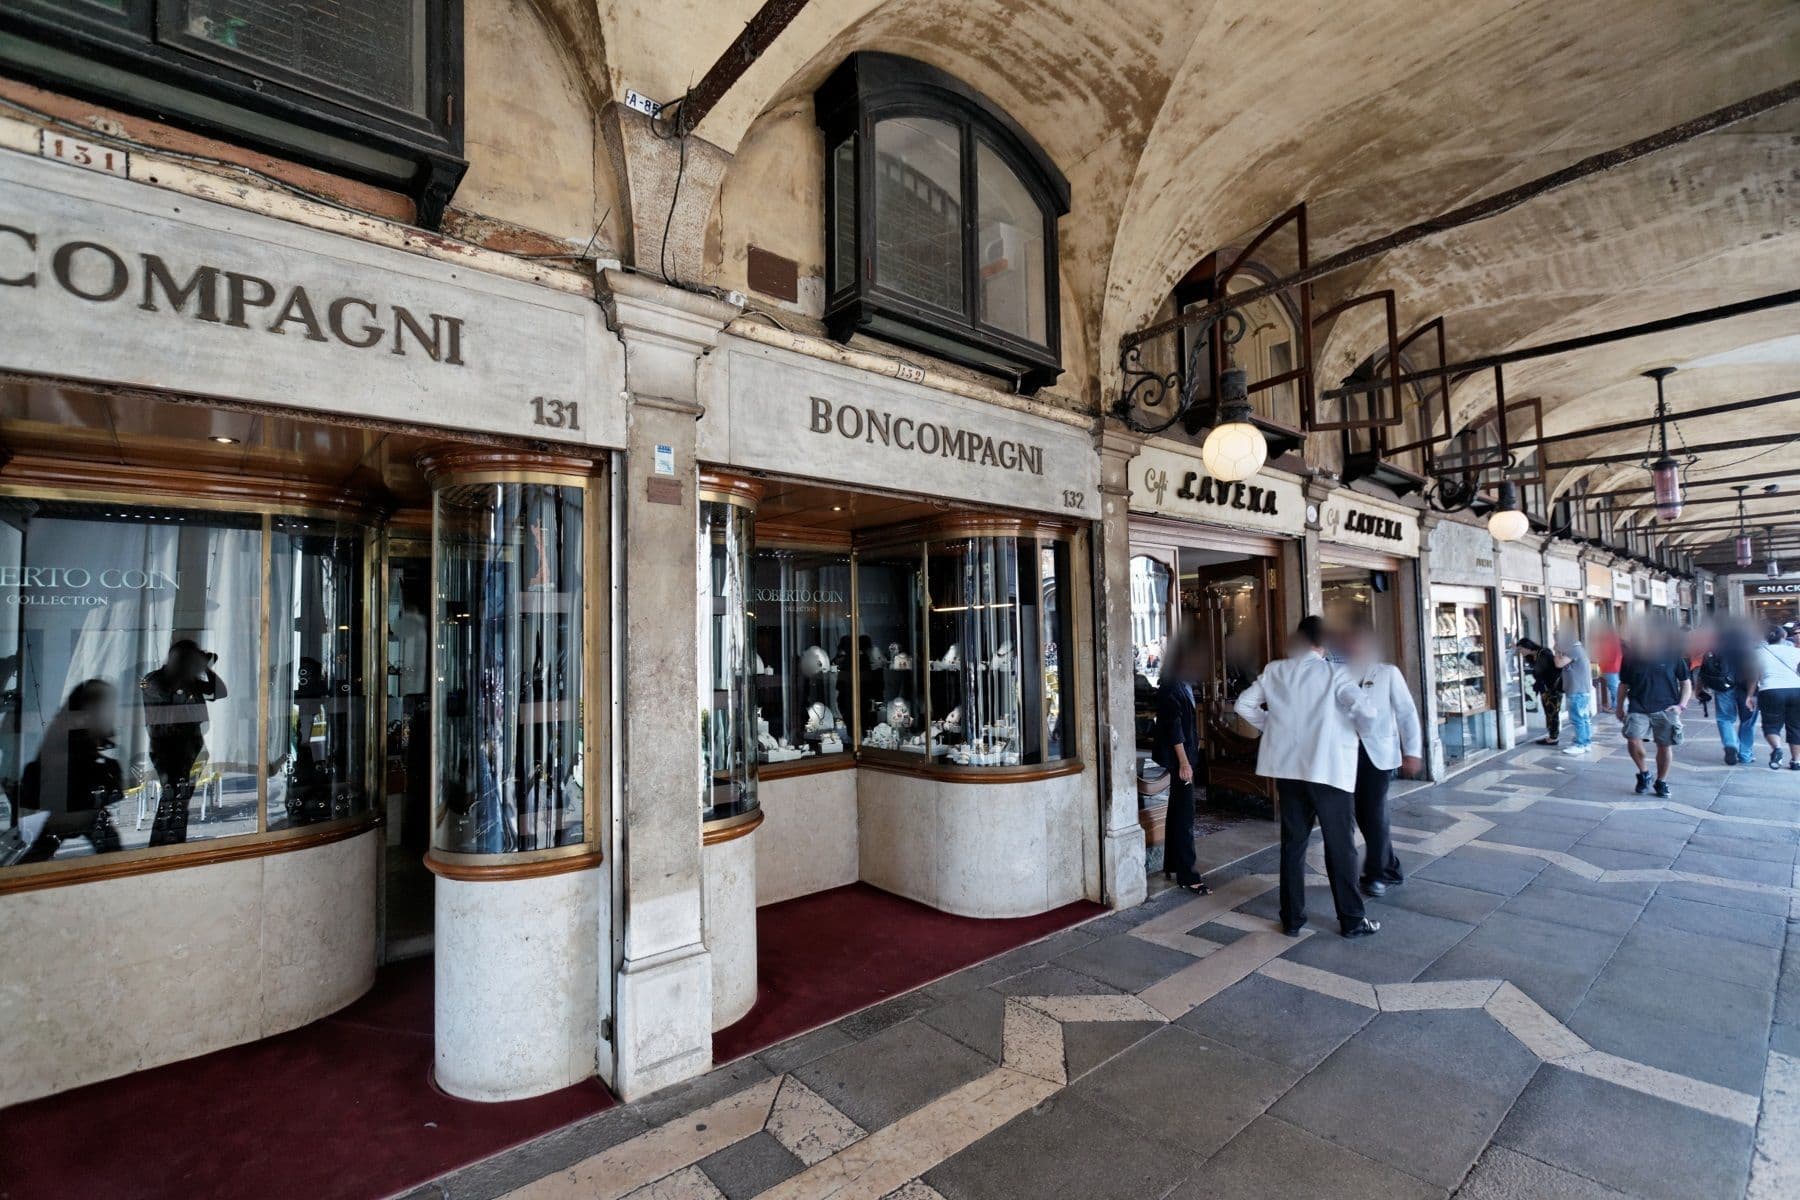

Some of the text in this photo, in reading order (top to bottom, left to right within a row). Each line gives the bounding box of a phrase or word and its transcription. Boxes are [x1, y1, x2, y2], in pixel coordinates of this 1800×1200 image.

[55, 140, 114, 171] 131
[530, 396, 580, 430] 131
[809, 396, 1044, 476] BONCOMPAGNI
[1063, 490, 1086, 509] 132
[1177, 471, 1279, 516] LAVENA
[1344, 510, 1403, 541] LAVENA
[100, 569, 182, 591] COIN
[6, 594, 108, 606] COLLECTION
[813, 591, 843, 603] COIN
